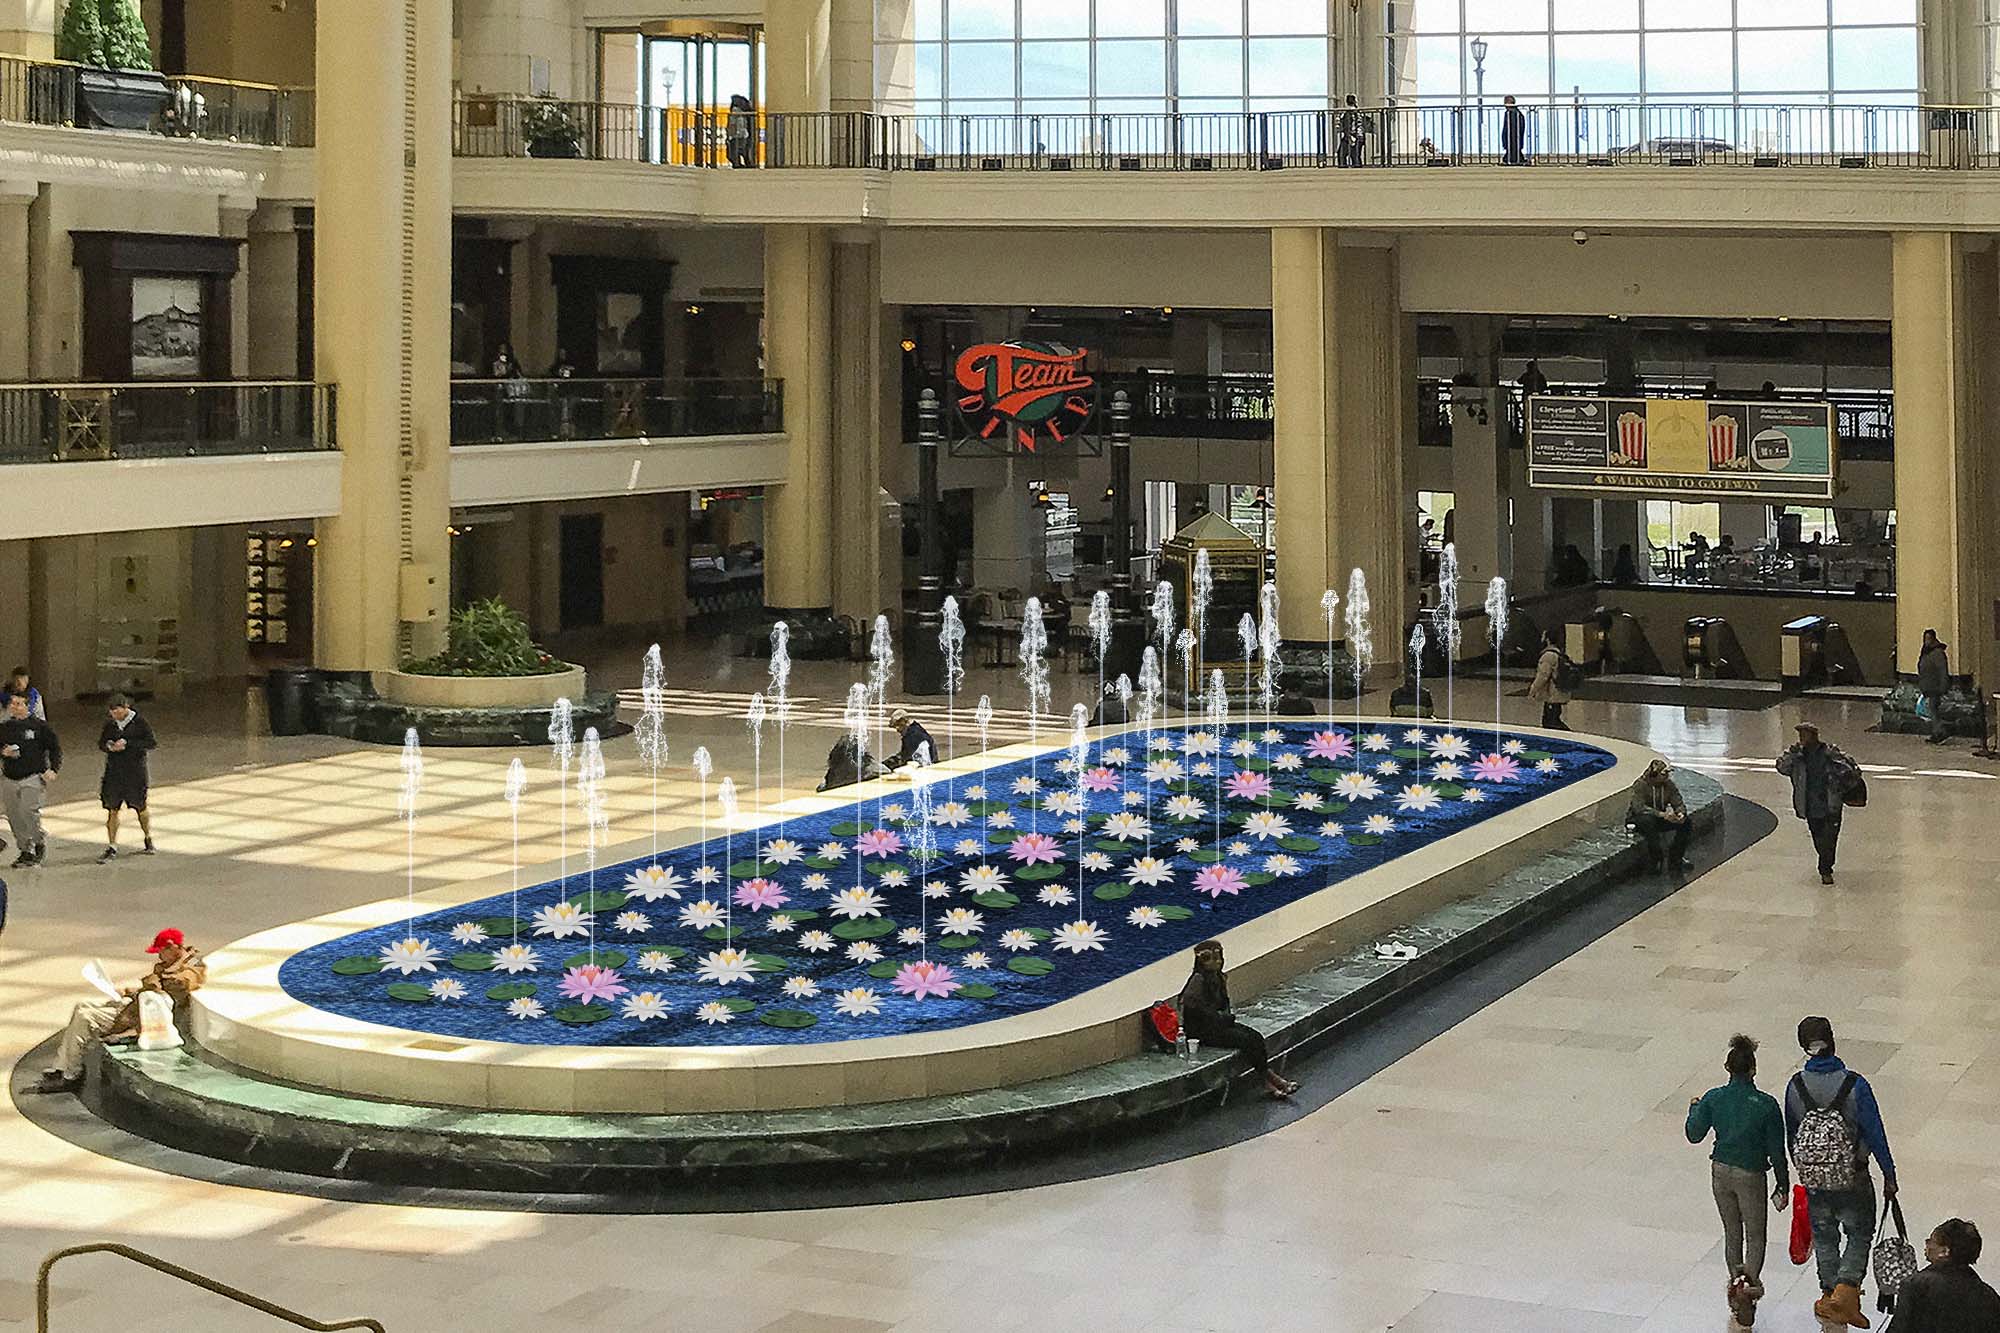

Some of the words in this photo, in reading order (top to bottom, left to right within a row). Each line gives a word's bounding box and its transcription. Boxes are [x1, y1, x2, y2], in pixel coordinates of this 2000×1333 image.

[955, 343, 1094, 414] Team
[1607, 475, 1673, 487] WALKWAY
[1679, 478, 1694, 488] TO
[1698, 478, 1761, 490] GATEWAY
